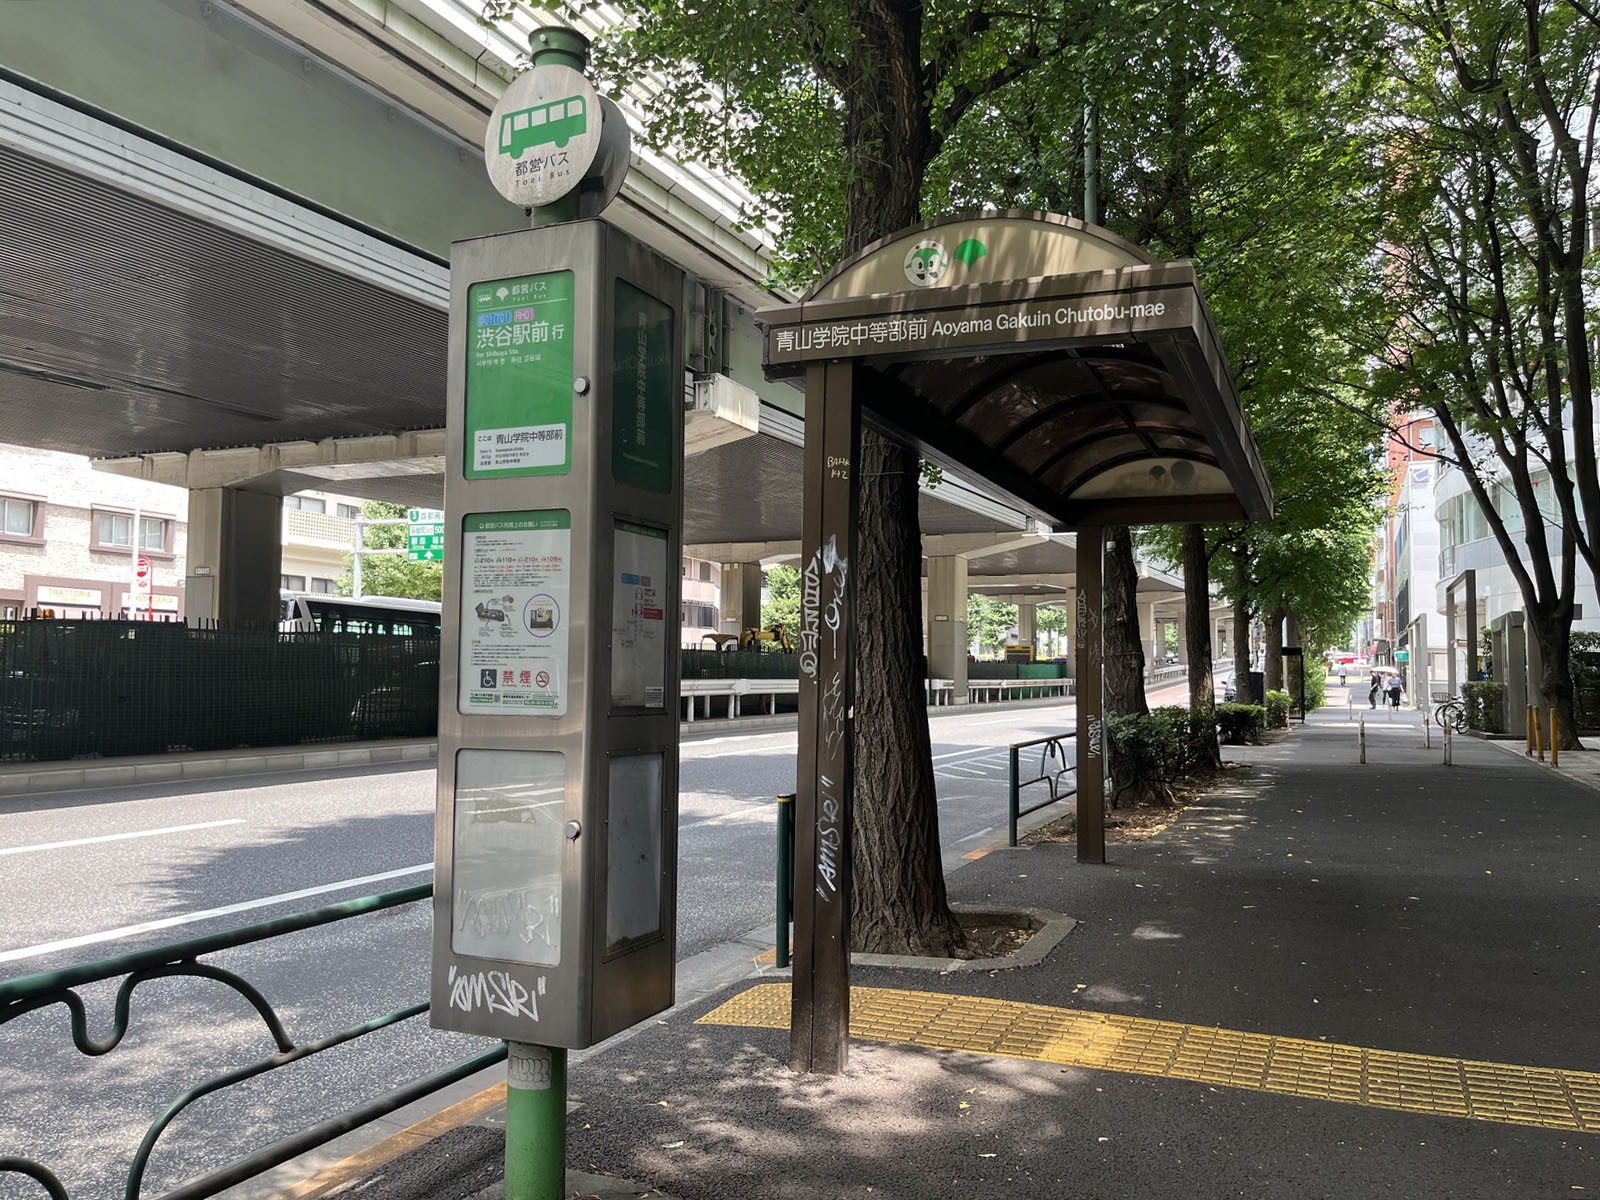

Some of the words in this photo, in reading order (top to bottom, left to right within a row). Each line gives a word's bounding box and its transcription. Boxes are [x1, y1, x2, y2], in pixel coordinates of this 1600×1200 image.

[515, 152, 569, 177] 都営バス
[515, 176, 542, 187] Toei
[550, 170, 570, 179] Bus
[512, 281, 547, 296] 都営バス
[476, 320, 549, 349] 渋谷駅前
[552, 324, 564, 340] 行
[776, 317, 927, 353] 青山学院中等部前
[931, 318, 993, 337] Aoyama
[996, 310, 1051, 330] Gakuin
[1055, 302, 1165, 325] Chutobu-mae
[496, 430, 563, 444] 青山学院中等部前
